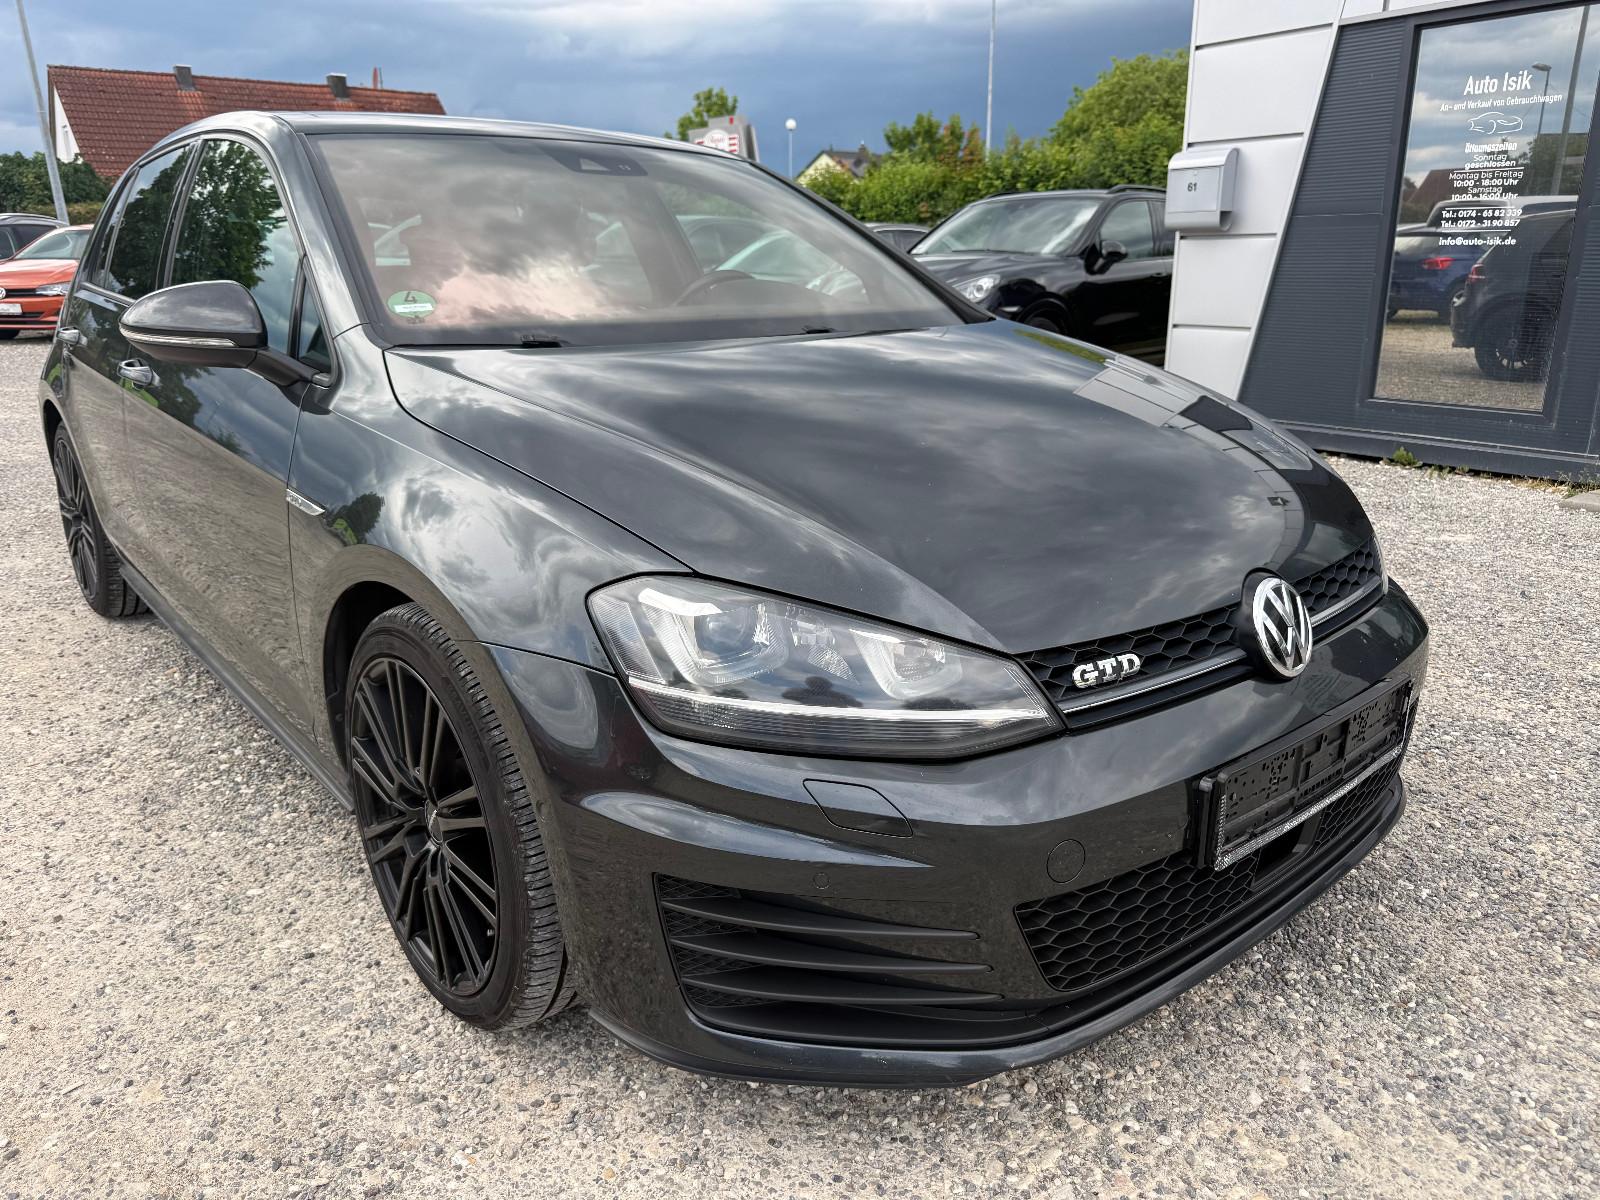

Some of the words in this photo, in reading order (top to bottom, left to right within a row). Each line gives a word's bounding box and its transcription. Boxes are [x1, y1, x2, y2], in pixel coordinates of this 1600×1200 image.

[1464, 75, 1498, 96] Auto
[1503, 70, 1533, 92] Isik
[1440, 103, 1453, 112] An-
[1453, 101, 1466, 110] und
[1467, 99, 1492, 110] Verkauf
[1493, 98, 1505, 106] von
[1506, 94, 1563, 106] Gebrauchtwagen
[1465, 161, 1516, 170] geschlossen
[1449, 172, 1479, 180] Montag
[1481, 171, 1493, 179] bis
[1494, 170, 1524, 179] Freitag
[1187, 182, 1198, 192] 61
[1453, 180, 1474, 188] 10:00
[1481, 179, 1502, 187] 18:00
[1503, 178, 1519, 186] Uhr
[1468, 186, 1503, 194] Samstag
[1442, 210, 1456, 218] Tel.:
[1458, 210, 1476, 218] 0174
[1506, 209, 1523, 217] 339
[1441, 220, 1456, 228] Tel.:
[1457, 220, 1476, 228] 0172
[1504, 219, 1520, 227] 857
[1439, 236, 1517, 246] info@auto-isik.de
[1072, 653, 1141, 689] GTD
